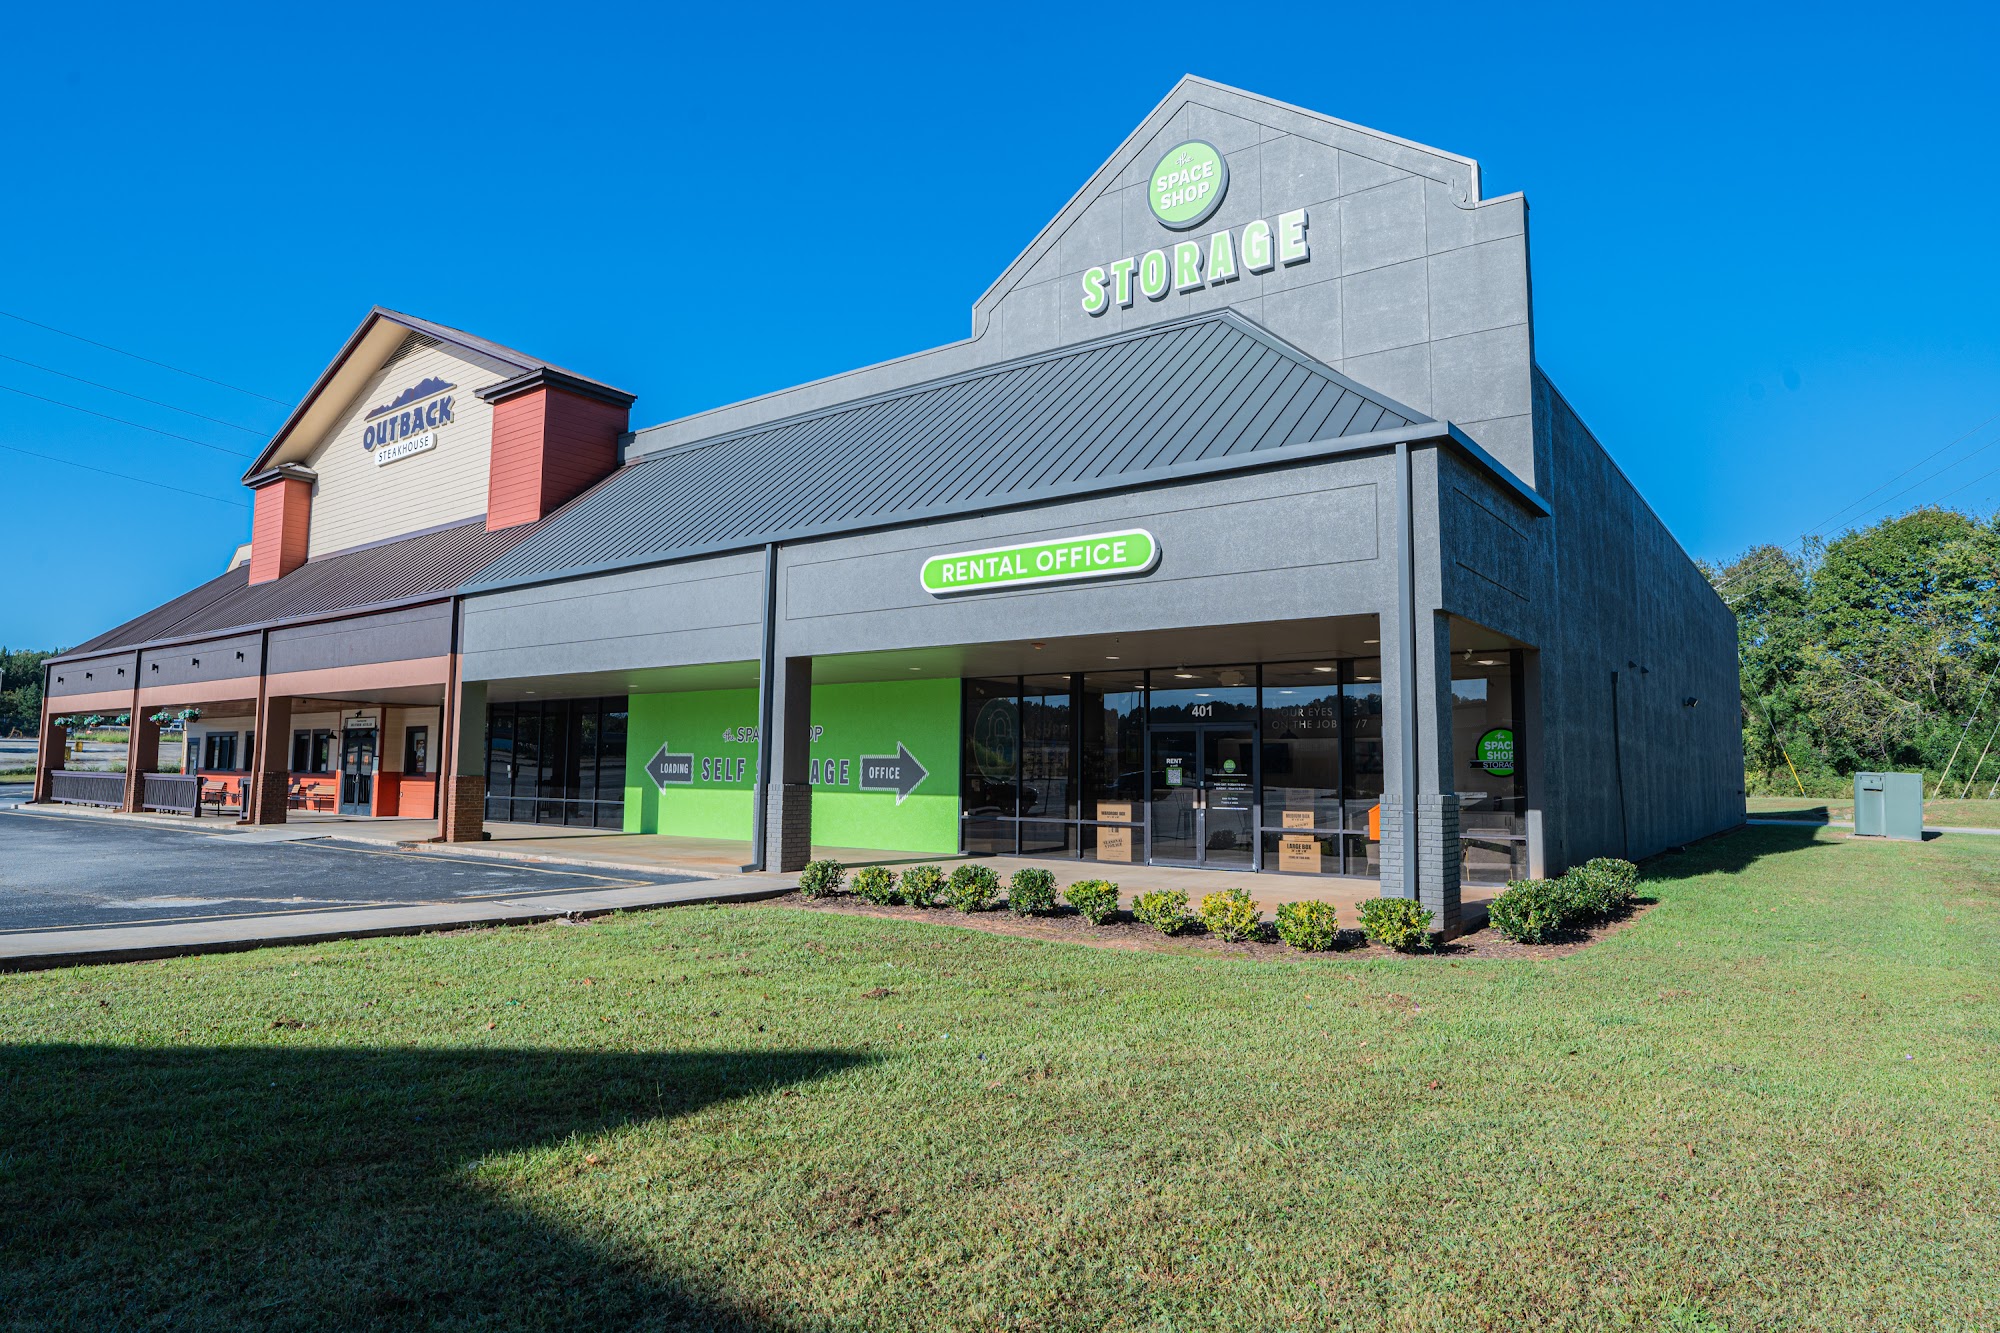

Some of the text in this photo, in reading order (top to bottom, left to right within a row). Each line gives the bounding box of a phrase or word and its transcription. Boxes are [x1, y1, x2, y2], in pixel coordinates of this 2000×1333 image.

[1175, 151, 1194, 167] the
[1157, 160, 1214, 193] SPACE
[1160, 181, 1210, 210] SHOP
[1081, 208, 1308, 316] STORAGE
[363, 395, 454, 452] OUTBACK
[379, 435, 429, 462] STEAKHOUSE
[941, 541, 1127, 583] RENTAL OFFICE
[1191, 704, 1213, 717] 401
[1281, 707, 1333, 717] OUR EYES
[722, 726, 760, 743] the SPA
[1271, 721, 1289, 730] ON
[1293, 720, 1312, 729] THE
[1316, 719, 1338, 729] JOB
[660, 763, 689, 774] LOADING
[701, 757, 747, 783] SELF
[868, 766, 900, 780] OFFICE
